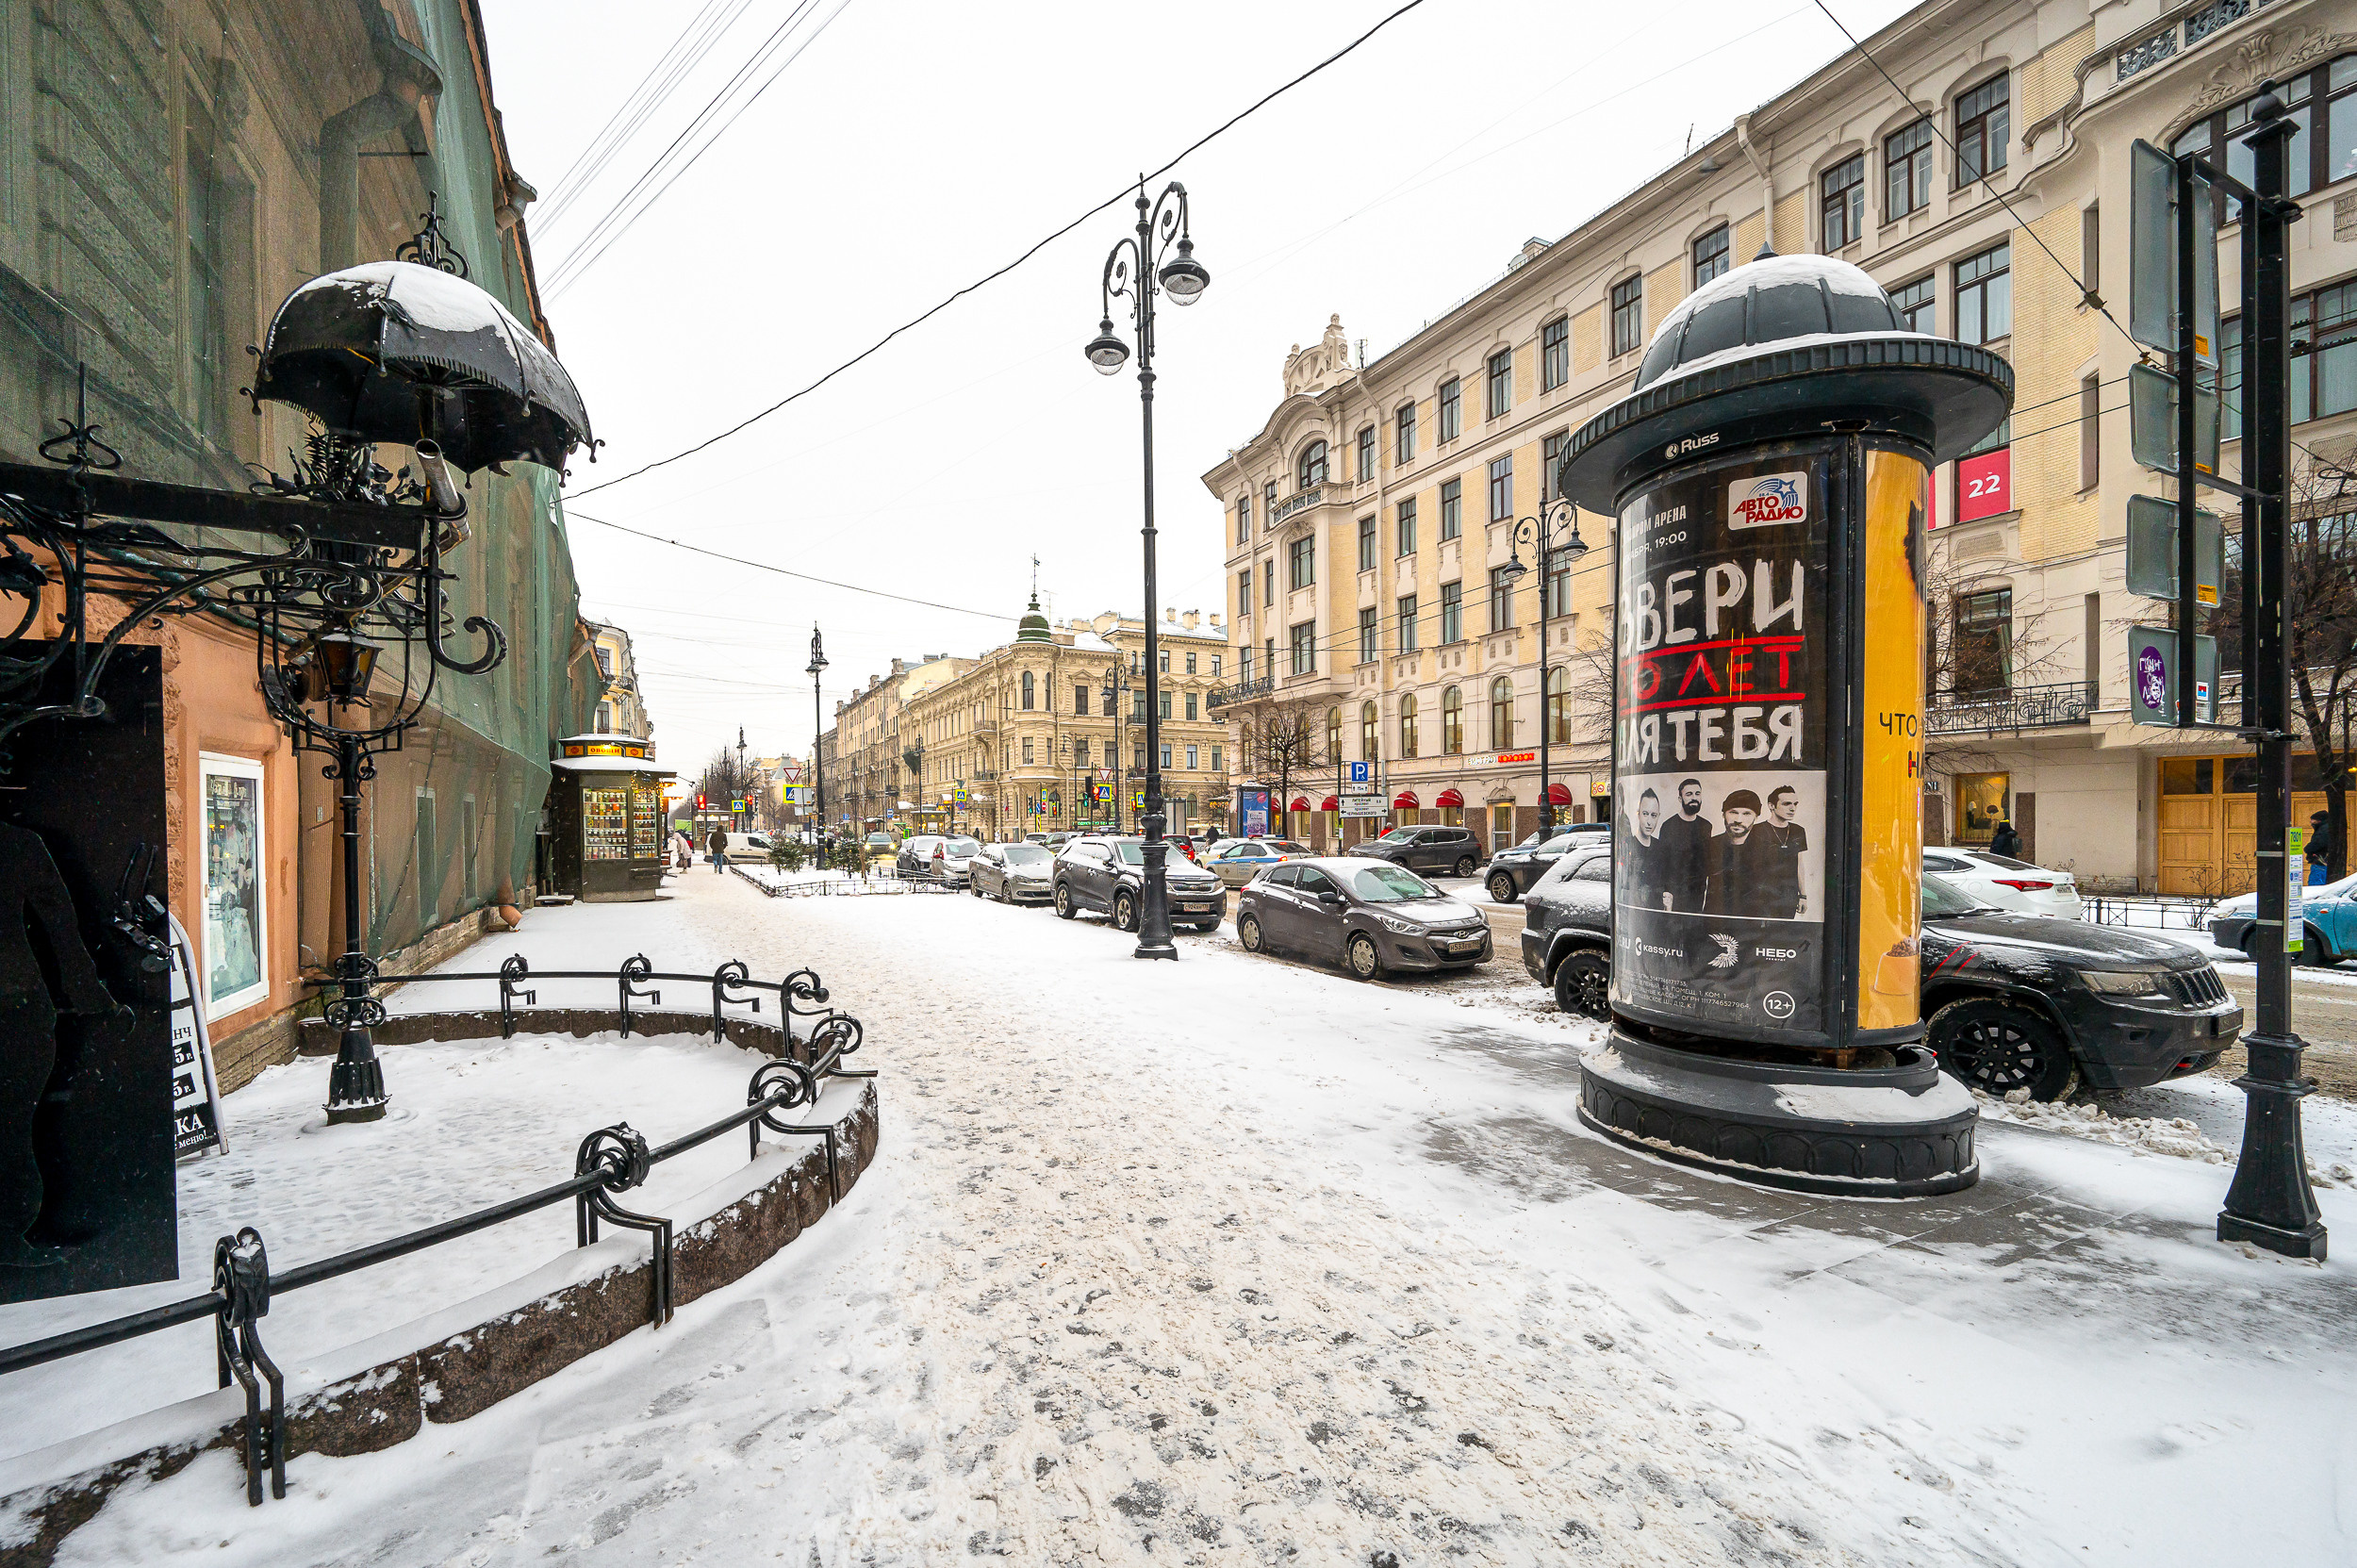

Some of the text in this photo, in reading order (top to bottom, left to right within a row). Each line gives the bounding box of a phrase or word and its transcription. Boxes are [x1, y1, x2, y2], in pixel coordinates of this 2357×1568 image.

[1681, 432, 1720, 454] Russ
[1968, 474, 2001, 499] 22
[1655, 505, 1687, 528] АРЕНА
[1733, 496, 1779, 515] АВТО
[1746, 506, 1804, 524] РАДИО
[1655, 531, 1687, 549] 19:00
[1620, 559, 1805, 657] ЗВЕРИ
[1678, 645, 1802, 696] ЛЕТ
[1667, 704, 1803, 763] ТЕБЯ
[1880, 712, 1918, 736] ЧТО
[1643, 945, 1684, 958] kassy.ru
[1755, 947, 1797, 959] НЕБО
[1767, 999, 1792, 1010] 12+
